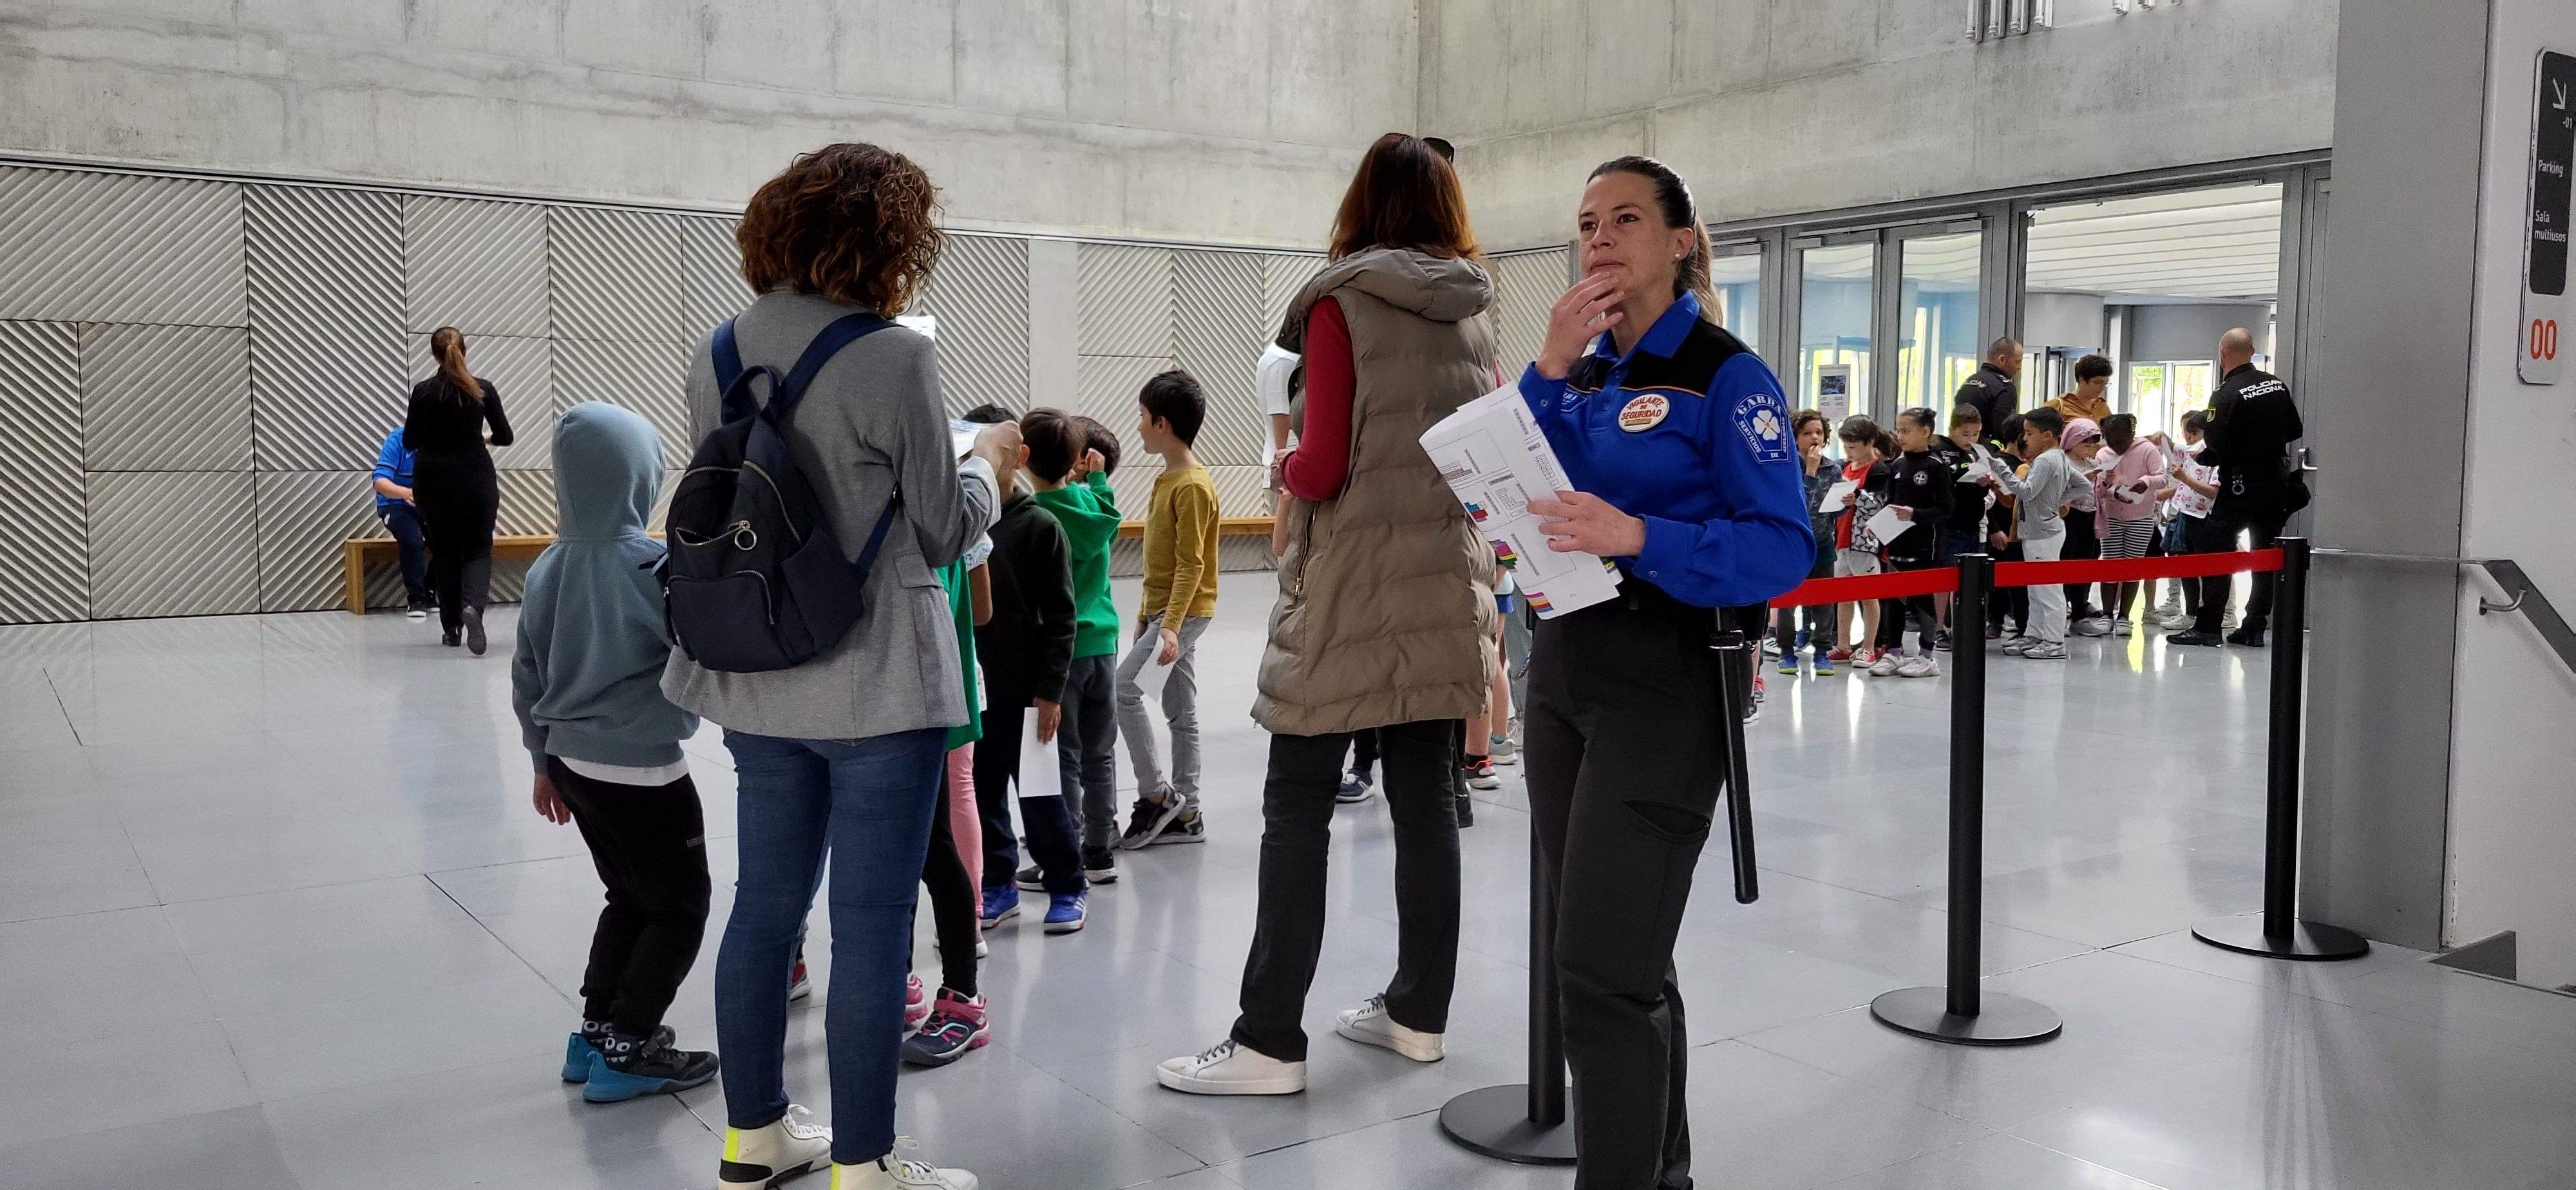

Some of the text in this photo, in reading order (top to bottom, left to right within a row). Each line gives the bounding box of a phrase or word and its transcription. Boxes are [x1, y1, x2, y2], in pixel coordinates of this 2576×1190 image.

[2562, 117, 2573, 129] -01
[2538, 159, 2564, 178] Parking
[2535, 209, 2550, 223] Sala
[2534, 228, 2566, 243] multiusos
[2530, 318, 2557, 361] 00
[2243, 384, 2286, 401] NACIONAL
[1627, 396, 1664, 410] VIGILANTE
[1738, 395, 1781, 415] GARDA
[1621, 409, 1662, 420] SEGURIDAD
[1739, 420, 1762, 453] SERVICIOS
